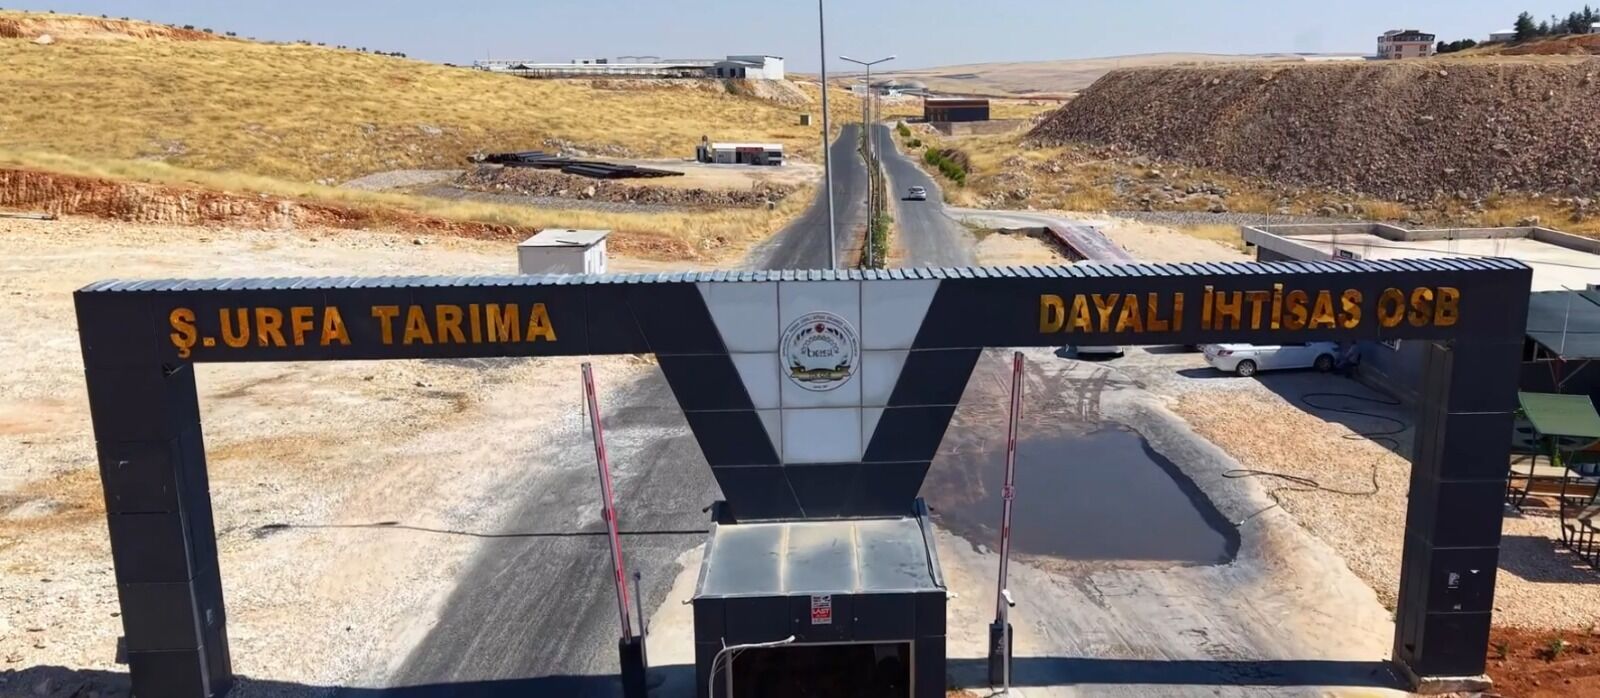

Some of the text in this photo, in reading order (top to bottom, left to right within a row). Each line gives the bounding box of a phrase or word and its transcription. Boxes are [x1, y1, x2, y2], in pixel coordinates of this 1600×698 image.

[169, 302, 558, 359] Ş.URFA TARIMA
[1038, 283, 1461, 334] DAYALI İHTİSAS OSB
